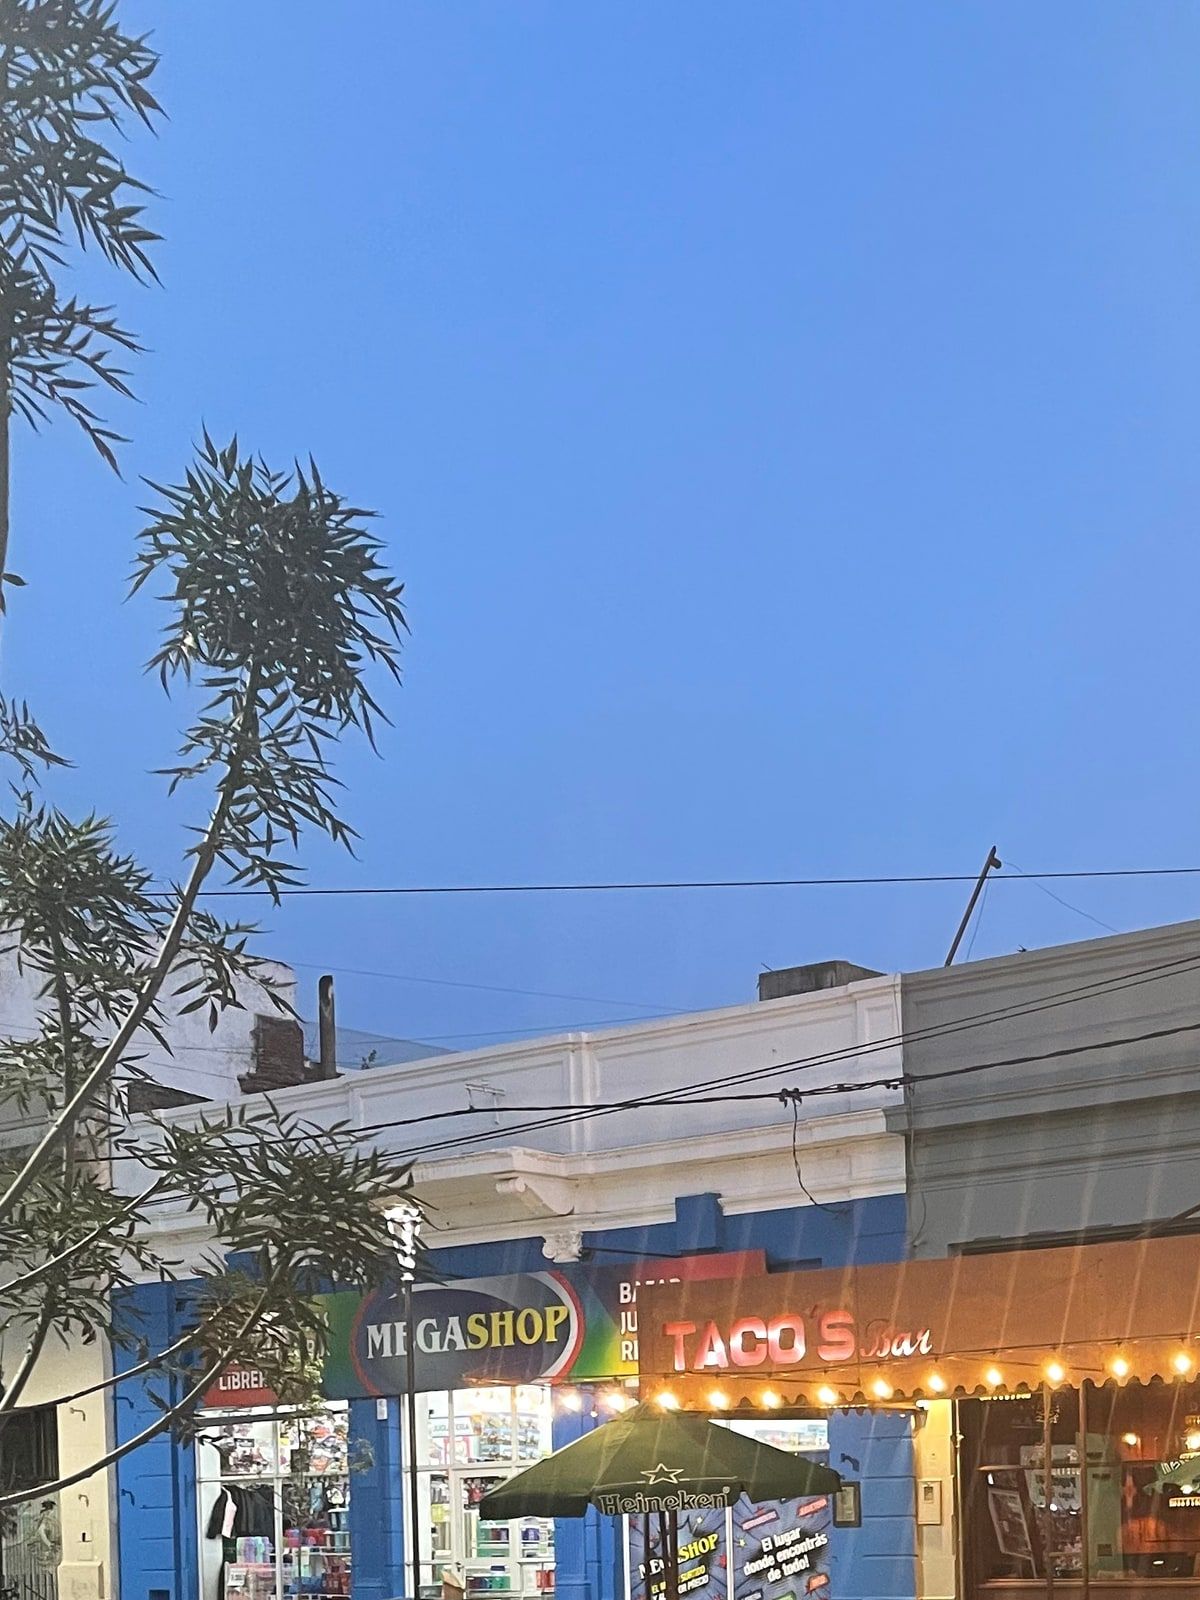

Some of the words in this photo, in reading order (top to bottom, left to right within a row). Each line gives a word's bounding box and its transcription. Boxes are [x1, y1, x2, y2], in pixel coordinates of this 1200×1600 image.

[662, 1304, 856, 1371] TACO'S
[860, 1318, 933, 1358] Bar
[599, 1489, 727, 1516] Heineken
[743, 1554, 775, 1576] donde
[776, 1532, 828, 1563] encontrás
[761, 1537, 773, 1553] El
[774, 1527, 801, 1548] lugar
[767, 1568, 782, 1583] de
[781, 1554, 811, 1576] todo!
